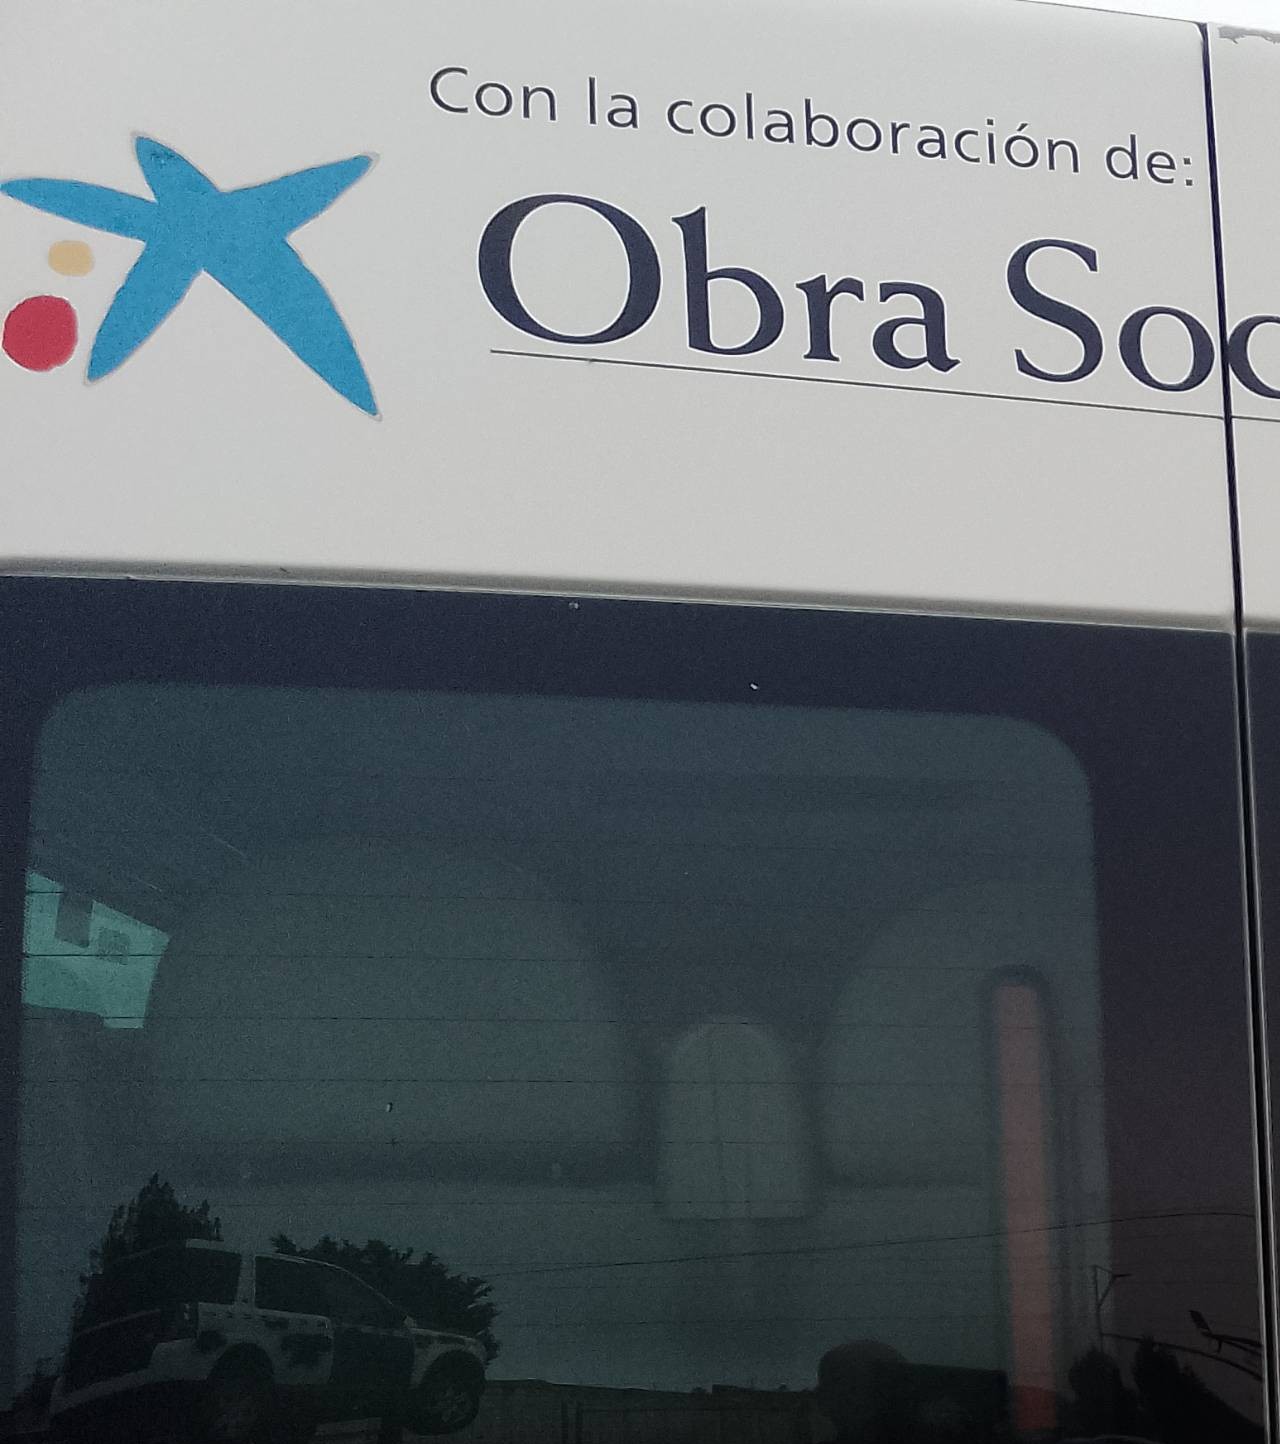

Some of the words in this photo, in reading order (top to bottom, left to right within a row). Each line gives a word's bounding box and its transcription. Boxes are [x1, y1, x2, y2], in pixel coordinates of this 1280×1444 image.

[429, 66, 557, 122] Con
[587, 77, 640, 129] la
[667, 92, 1081, 175] colaboración
[1105, 134, 1195, 187] de:
[477, 193, 961, 373] Obra
